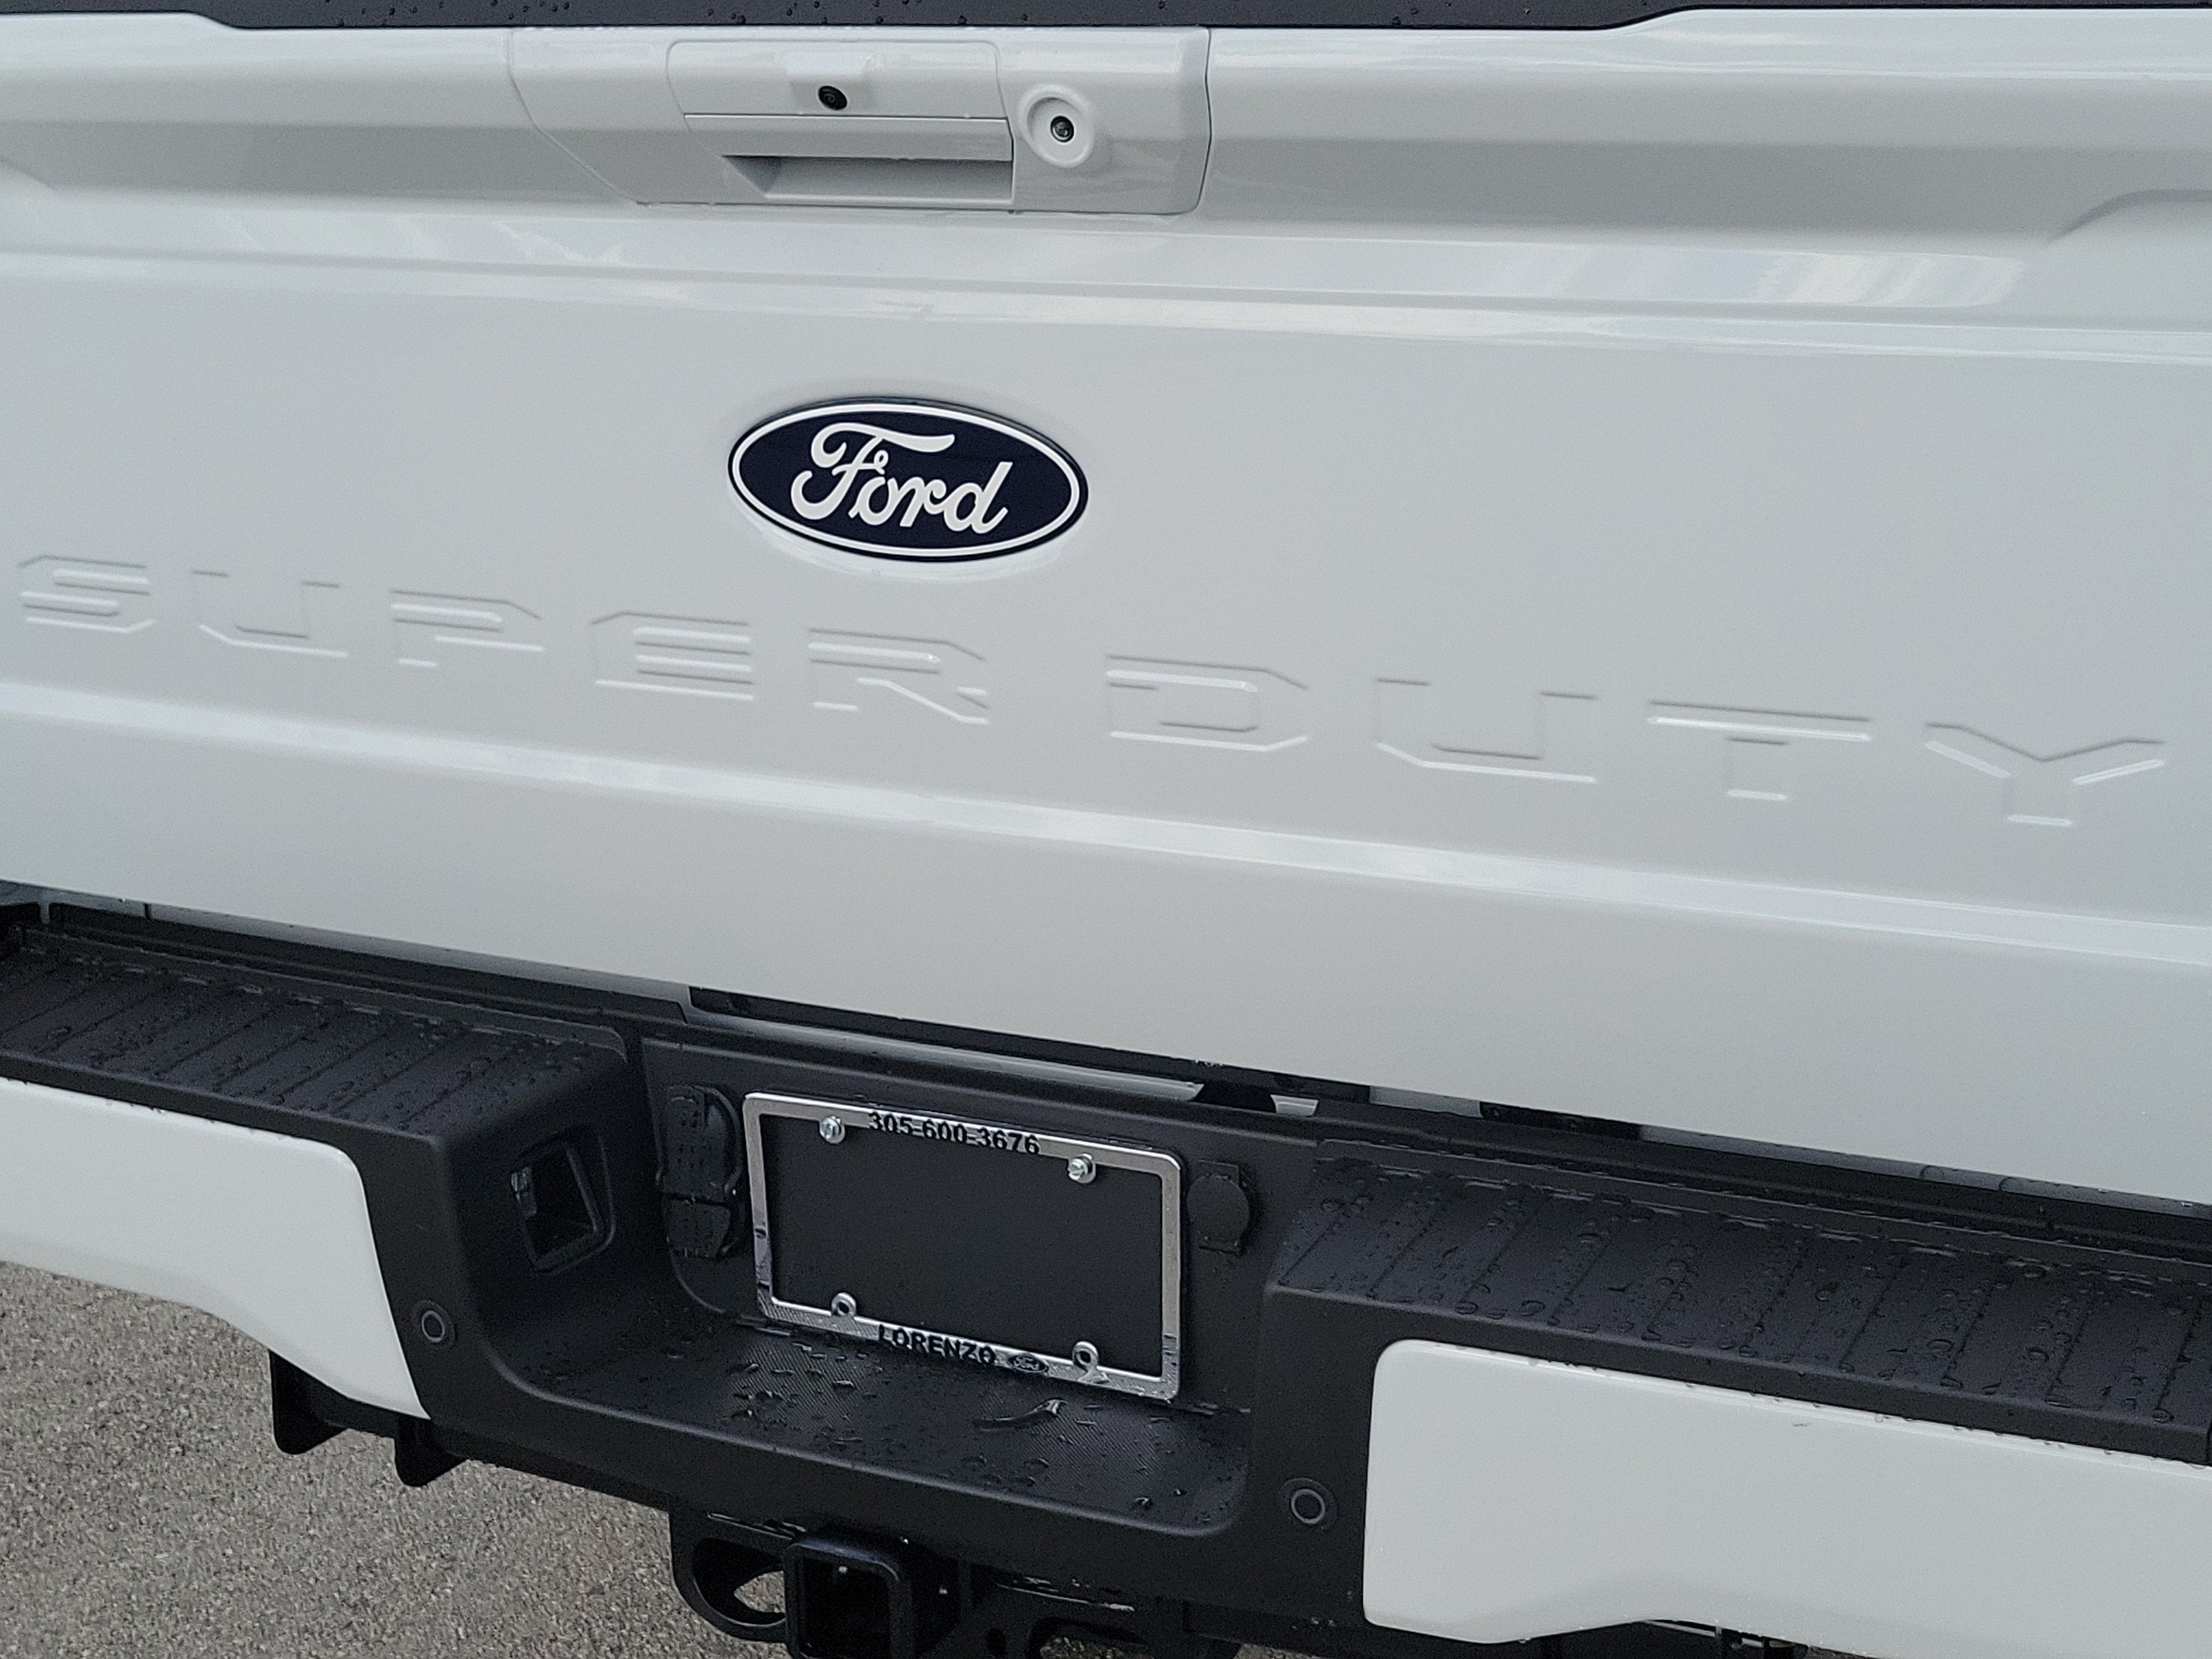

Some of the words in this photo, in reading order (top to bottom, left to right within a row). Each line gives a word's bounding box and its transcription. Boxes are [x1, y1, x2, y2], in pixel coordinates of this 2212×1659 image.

[791, 422, 1013, 534] Ford
[18, 554, 990, 726] SUPER
[1104, 654, 2164, 826] DUTY
[868, 1111, 1040, 1155] 305-600-3676
[879, 1324, 996, 1365] LORENZO
